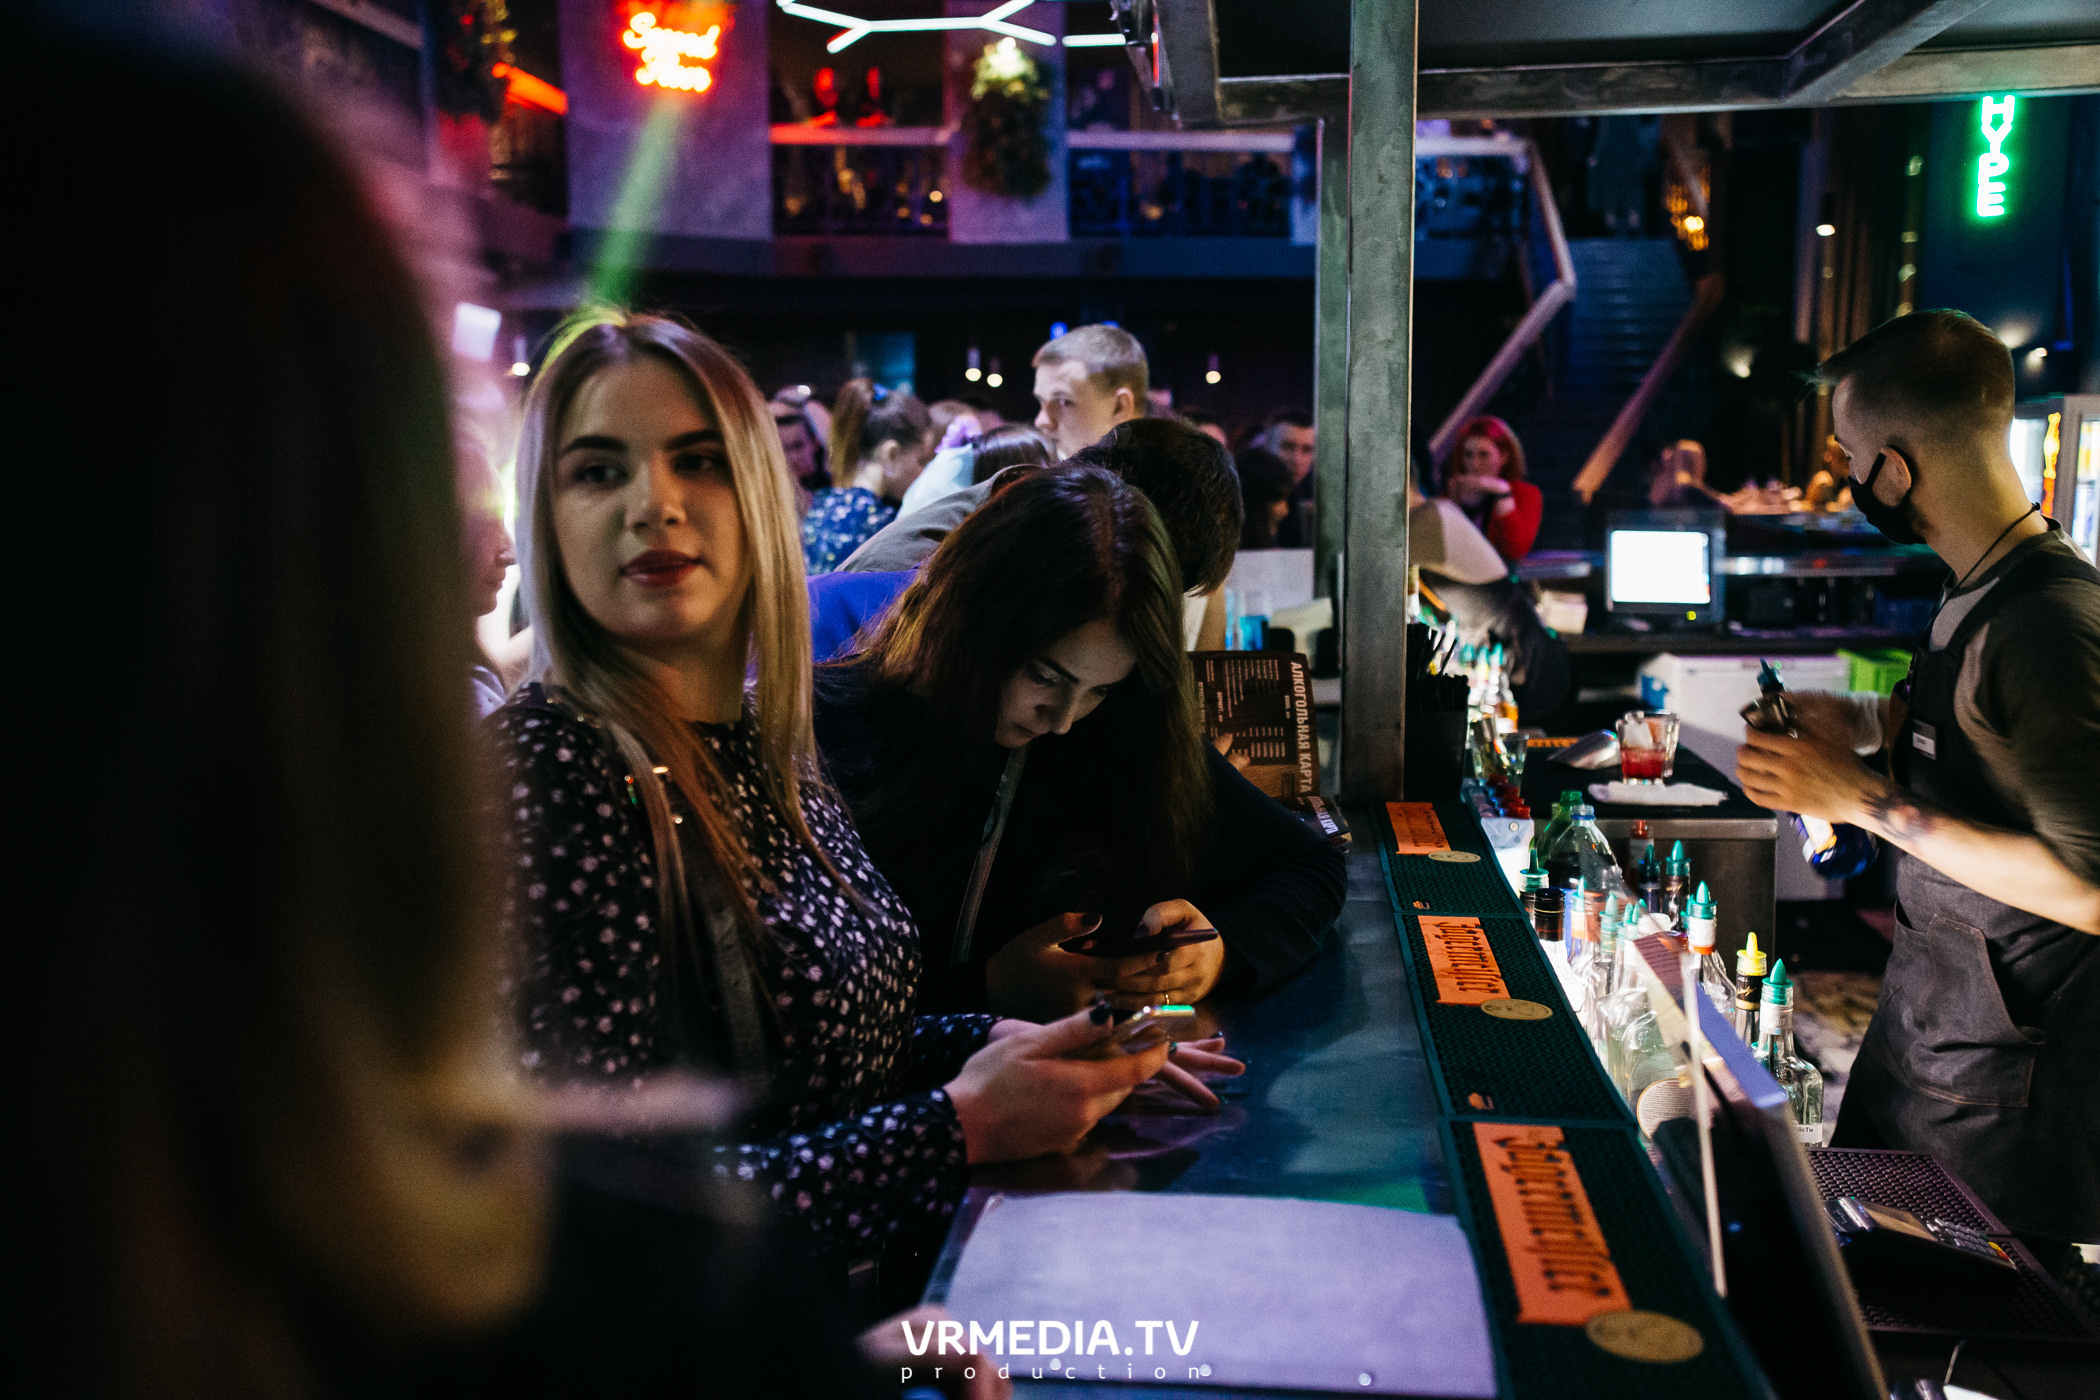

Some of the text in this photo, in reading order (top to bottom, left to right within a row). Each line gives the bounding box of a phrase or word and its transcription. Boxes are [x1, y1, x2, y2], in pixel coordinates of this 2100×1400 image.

[1977, 94, 2016, 217] HYPE
[1290, 661, 1310, 750] АЛКОГОЛЬНАЯ
[1299, 753, 1313, 793] КАРТА
